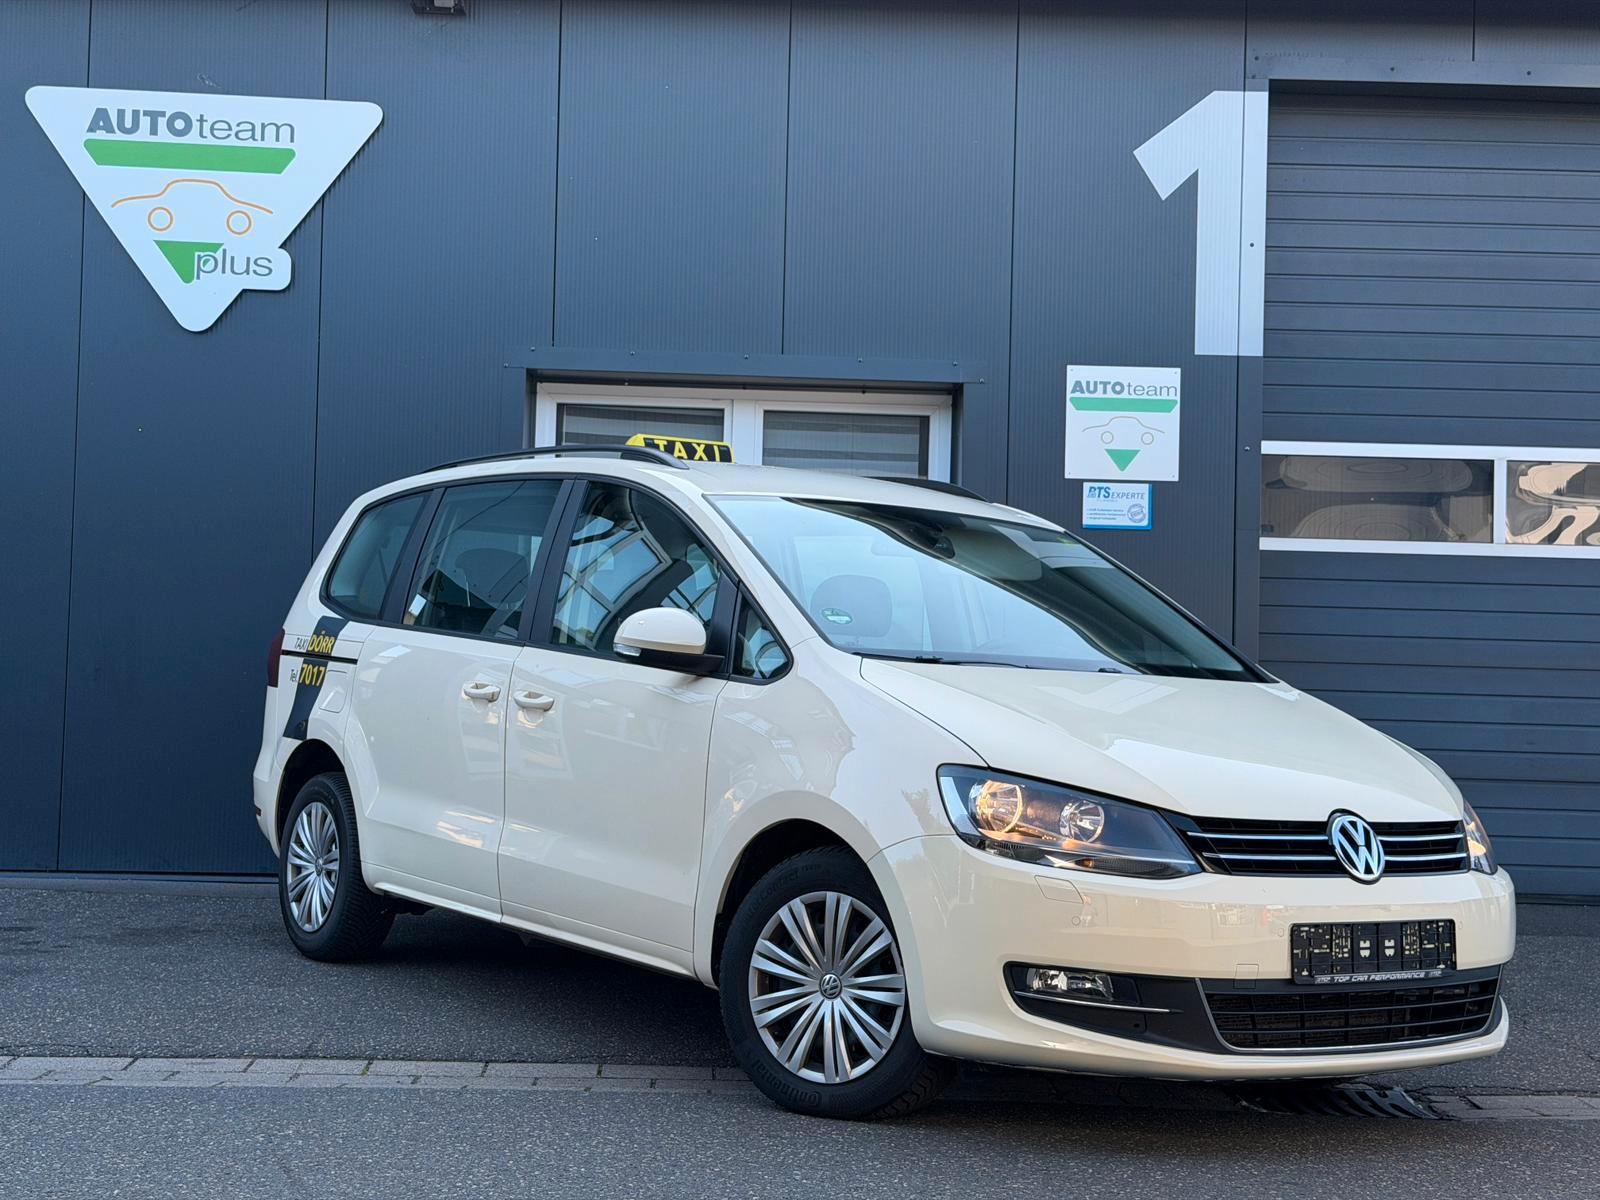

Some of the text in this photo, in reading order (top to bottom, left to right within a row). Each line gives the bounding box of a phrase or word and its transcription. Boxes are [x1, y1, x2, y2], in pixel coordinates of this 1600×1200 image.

[86, 107, 296, 143] AUTOteam
[1132, 90, 1269, 357] 1
[196, 248, 274, 281] plus
[1070, 380, 1178, 397] AUTOteam
[654, 439, 720, 462] TAXI
[1111, 491, 1145, 500] EXPERTE
[299, 664, 326, 687] 7017
[1331, 814, 1385, 881] VW
[1369, 971, 1426, 981] PERFORMANCE
